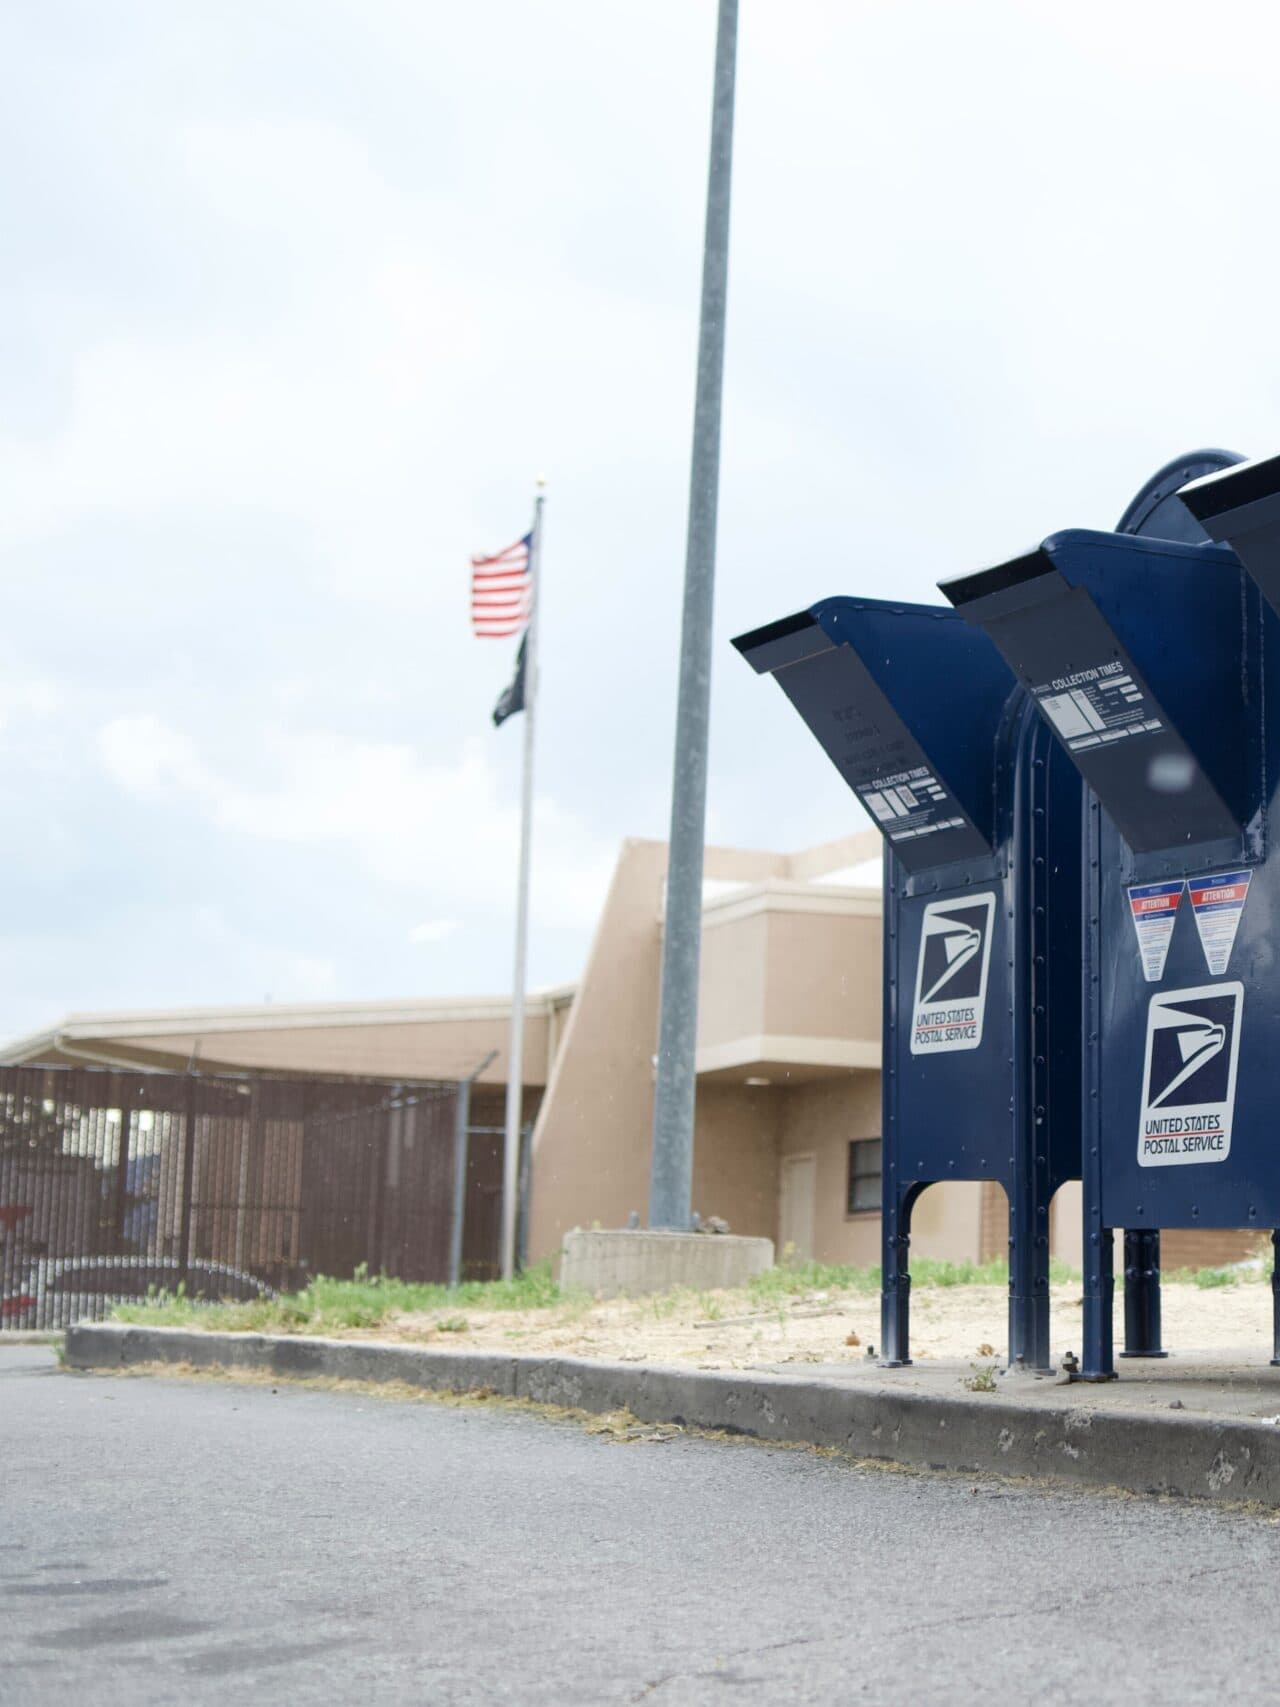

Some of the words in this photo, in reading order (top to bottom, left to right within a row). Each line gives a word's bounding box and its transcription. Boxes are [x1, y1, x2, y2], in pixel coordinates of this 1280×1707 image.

[1052, 668, 1099, 690] COLLECTION
[1098, 661, 1124, 677] TIMES
[872, 772, 910, 789] COLLECTION
[908, 766, 930, 779] TIMES
[1141, 897, 1170, 910] ATTENTION
[1202, 888, 1235, 902] ATTENTION
[916, 1011, 946, 1027] UNITED
[947, 1008, 975, 1024] STATES
[914, 1030, 943, 1045] POSTAL
[945, 1025, 977, 1042] SERVICE
[1145, 1117, 1183, 1136] UNITED
[1184, 1114, 1221, 1131] STATES
[1144, 1138, 1181, 1155] POSTAL
[1182, 1134, 1225, 1152] SERVICE
